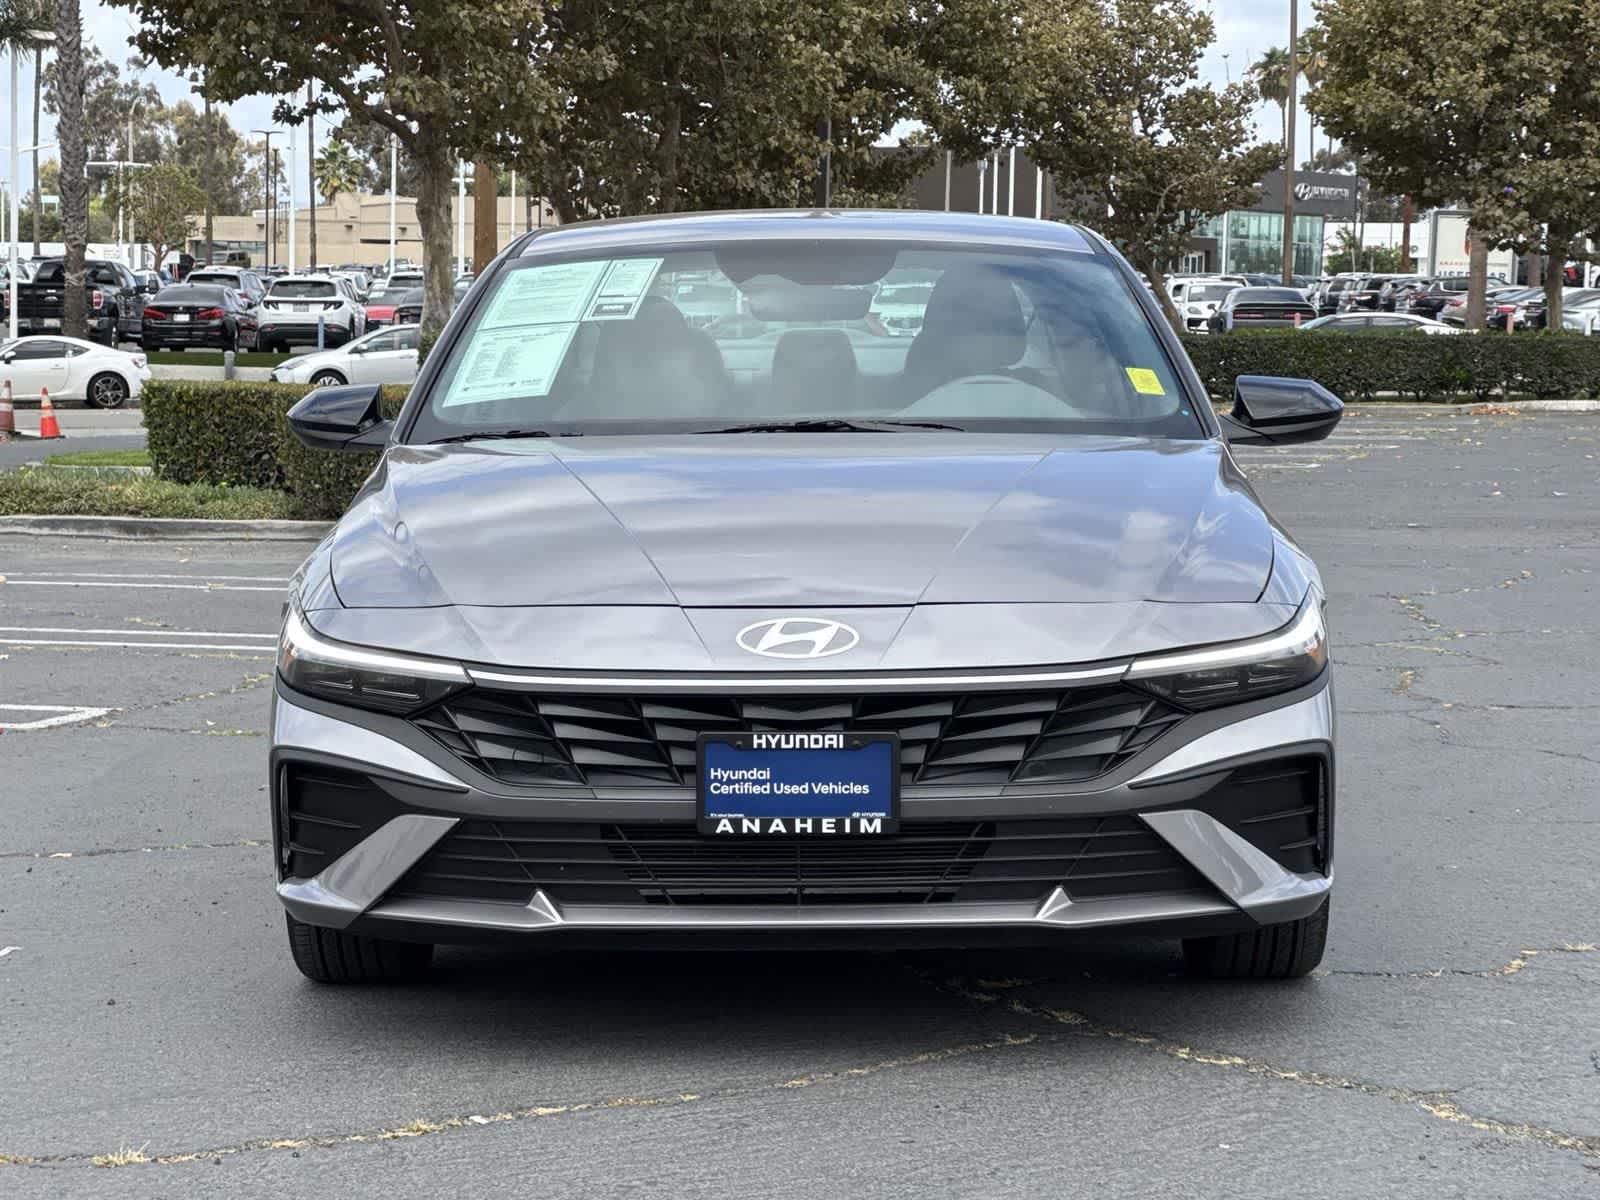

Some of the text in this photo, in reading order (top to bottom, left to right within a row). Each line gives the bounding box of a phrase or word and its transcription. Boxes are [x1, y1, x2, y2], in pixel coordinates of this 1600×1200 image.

[752, 734, 844, 749] HYUNDAI
[710, 768, 771, 782] Hyundai
[710, 782, 870, 795] Certified Used Vehicles
[715, 818, 882, 834] ANAHEIM
